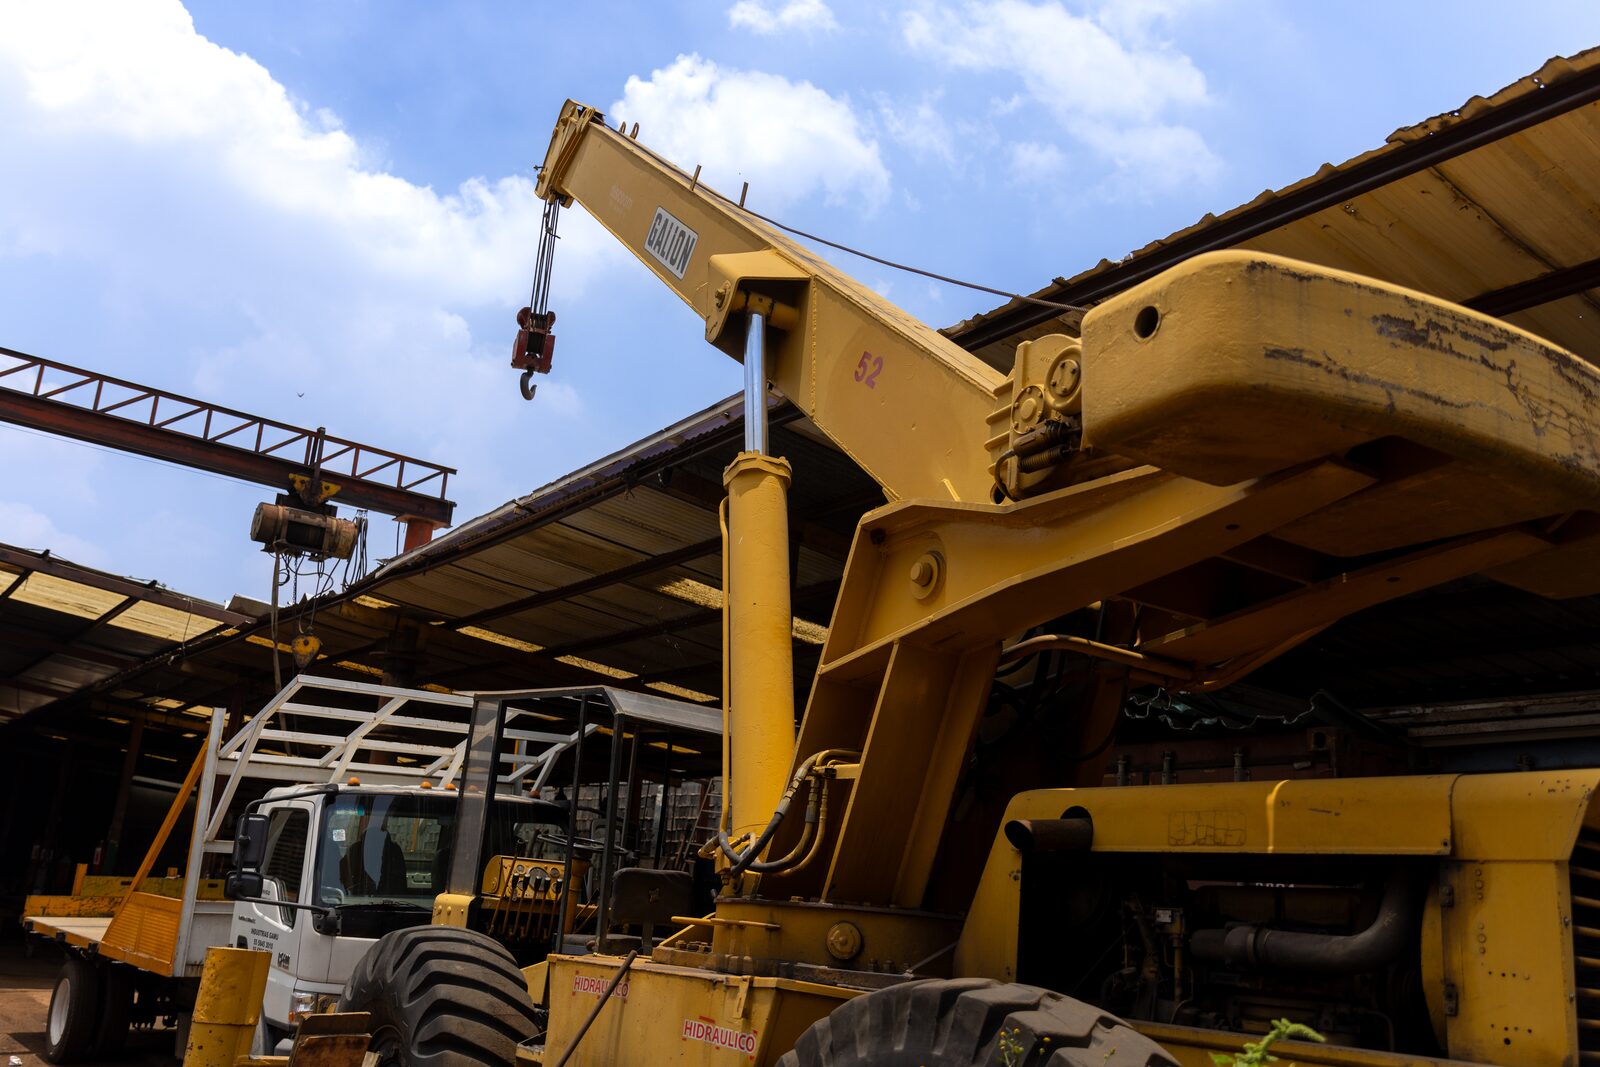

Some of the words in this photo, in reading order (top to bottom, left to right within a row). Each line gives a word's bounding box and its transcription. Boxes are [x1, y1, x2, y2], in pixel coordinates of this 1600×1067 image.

[647, 213, 696, 274] GALION
[854, 351, 883, 389] 52
[573, 976, 629, 997] HIDRAUCO
[684, 1020, 755, 1052] HIDRAULICO
